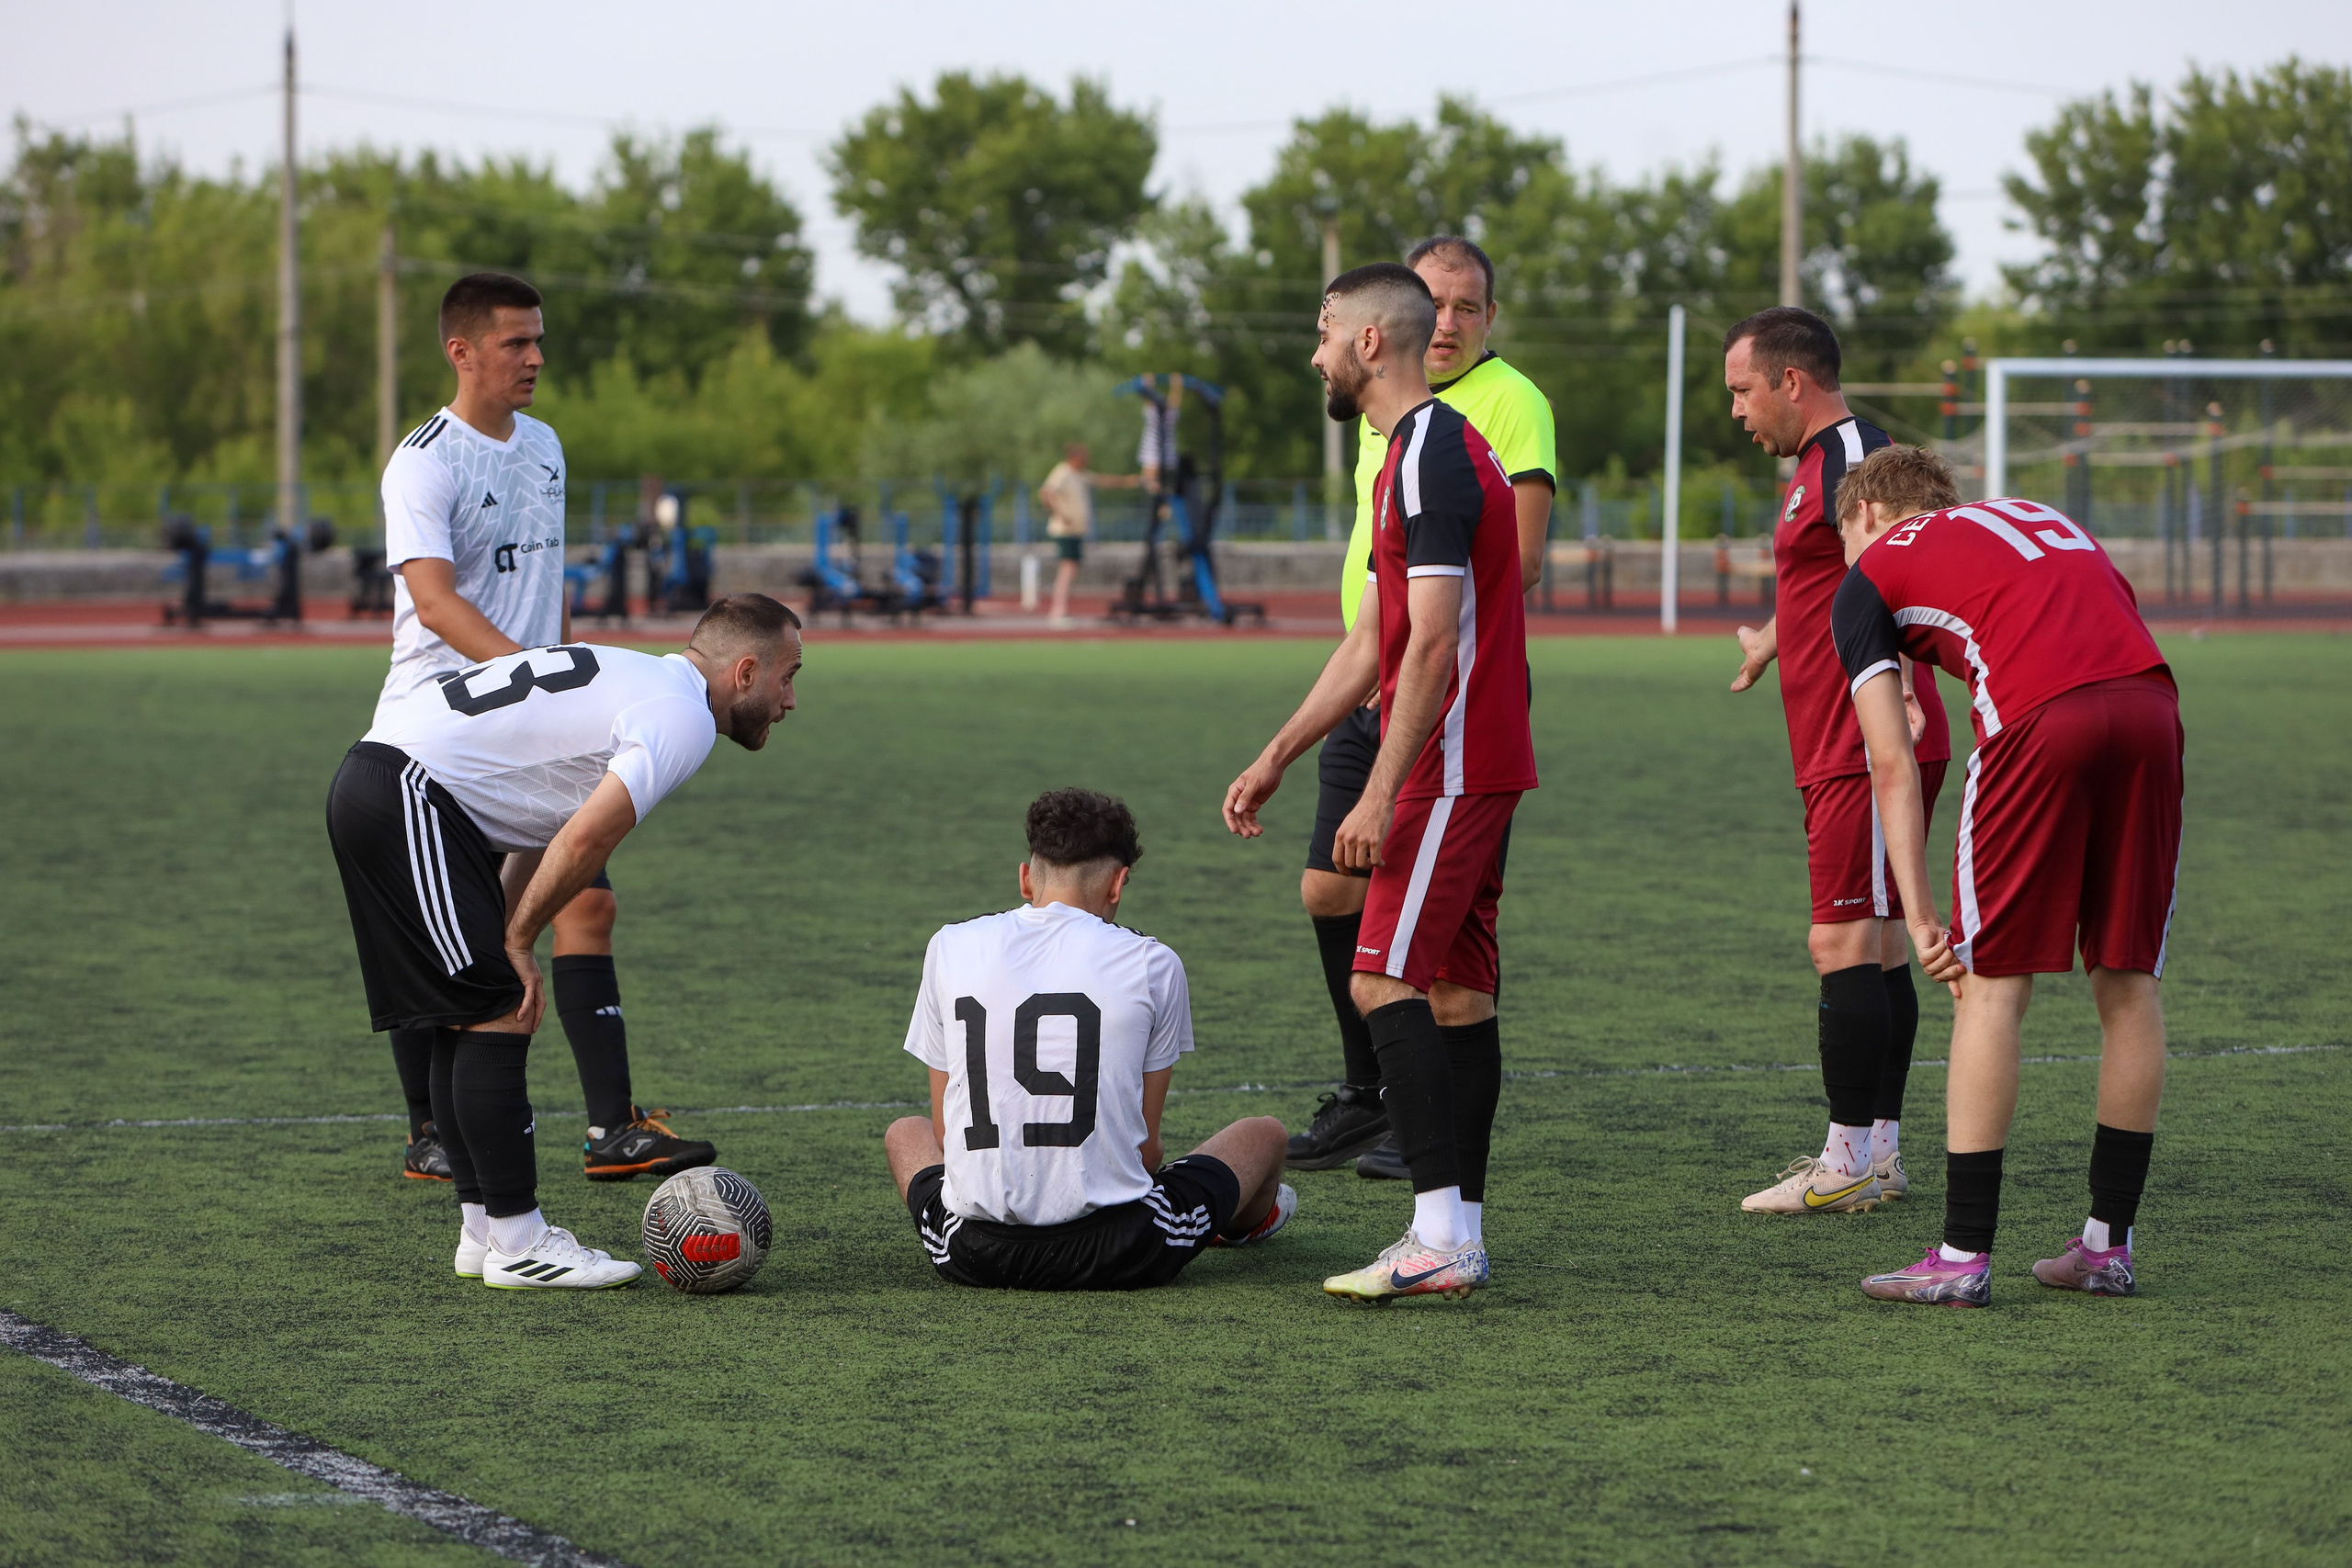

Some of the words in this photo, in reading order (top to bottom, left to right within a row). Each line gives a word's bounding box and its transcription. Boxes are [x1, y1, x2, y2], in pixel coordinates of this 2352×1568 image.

[520, 541, 543, 553] Coin
[545, 536, 559, 548] Tab
[1946, 499, 2096, 561] 19
[436, 644, 600, 716] 3
[1845, 897, 1866, 906] SPORT
[1362, 946, 1381, 955] SPORT
[955, 992, 1101, 1151] 19
